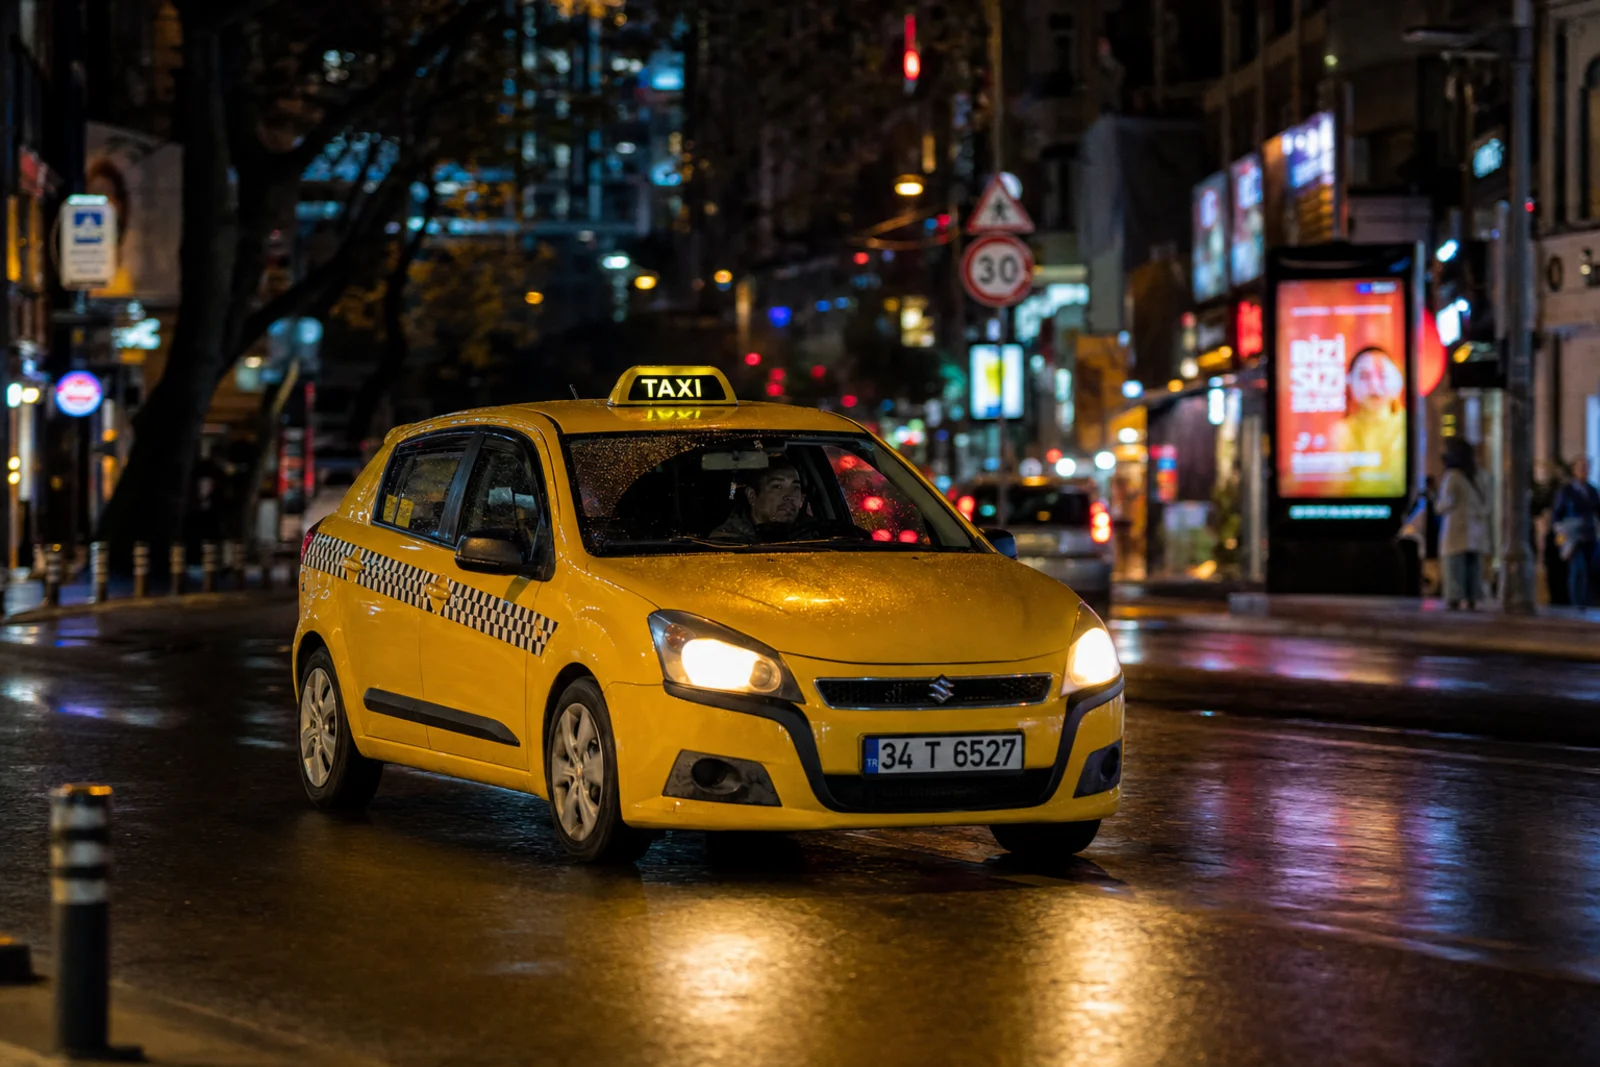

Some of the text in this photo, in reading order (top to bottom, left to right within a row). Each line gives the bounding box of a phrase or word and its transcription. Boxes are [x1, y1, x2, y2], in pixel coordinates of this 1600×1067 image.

[978, 255, 1019, 285] 30
[641, 378, 702, 398] TAXI
[867, 758, 878, 767] TR
[881, 738, 1017, 770] 34 T 6527
